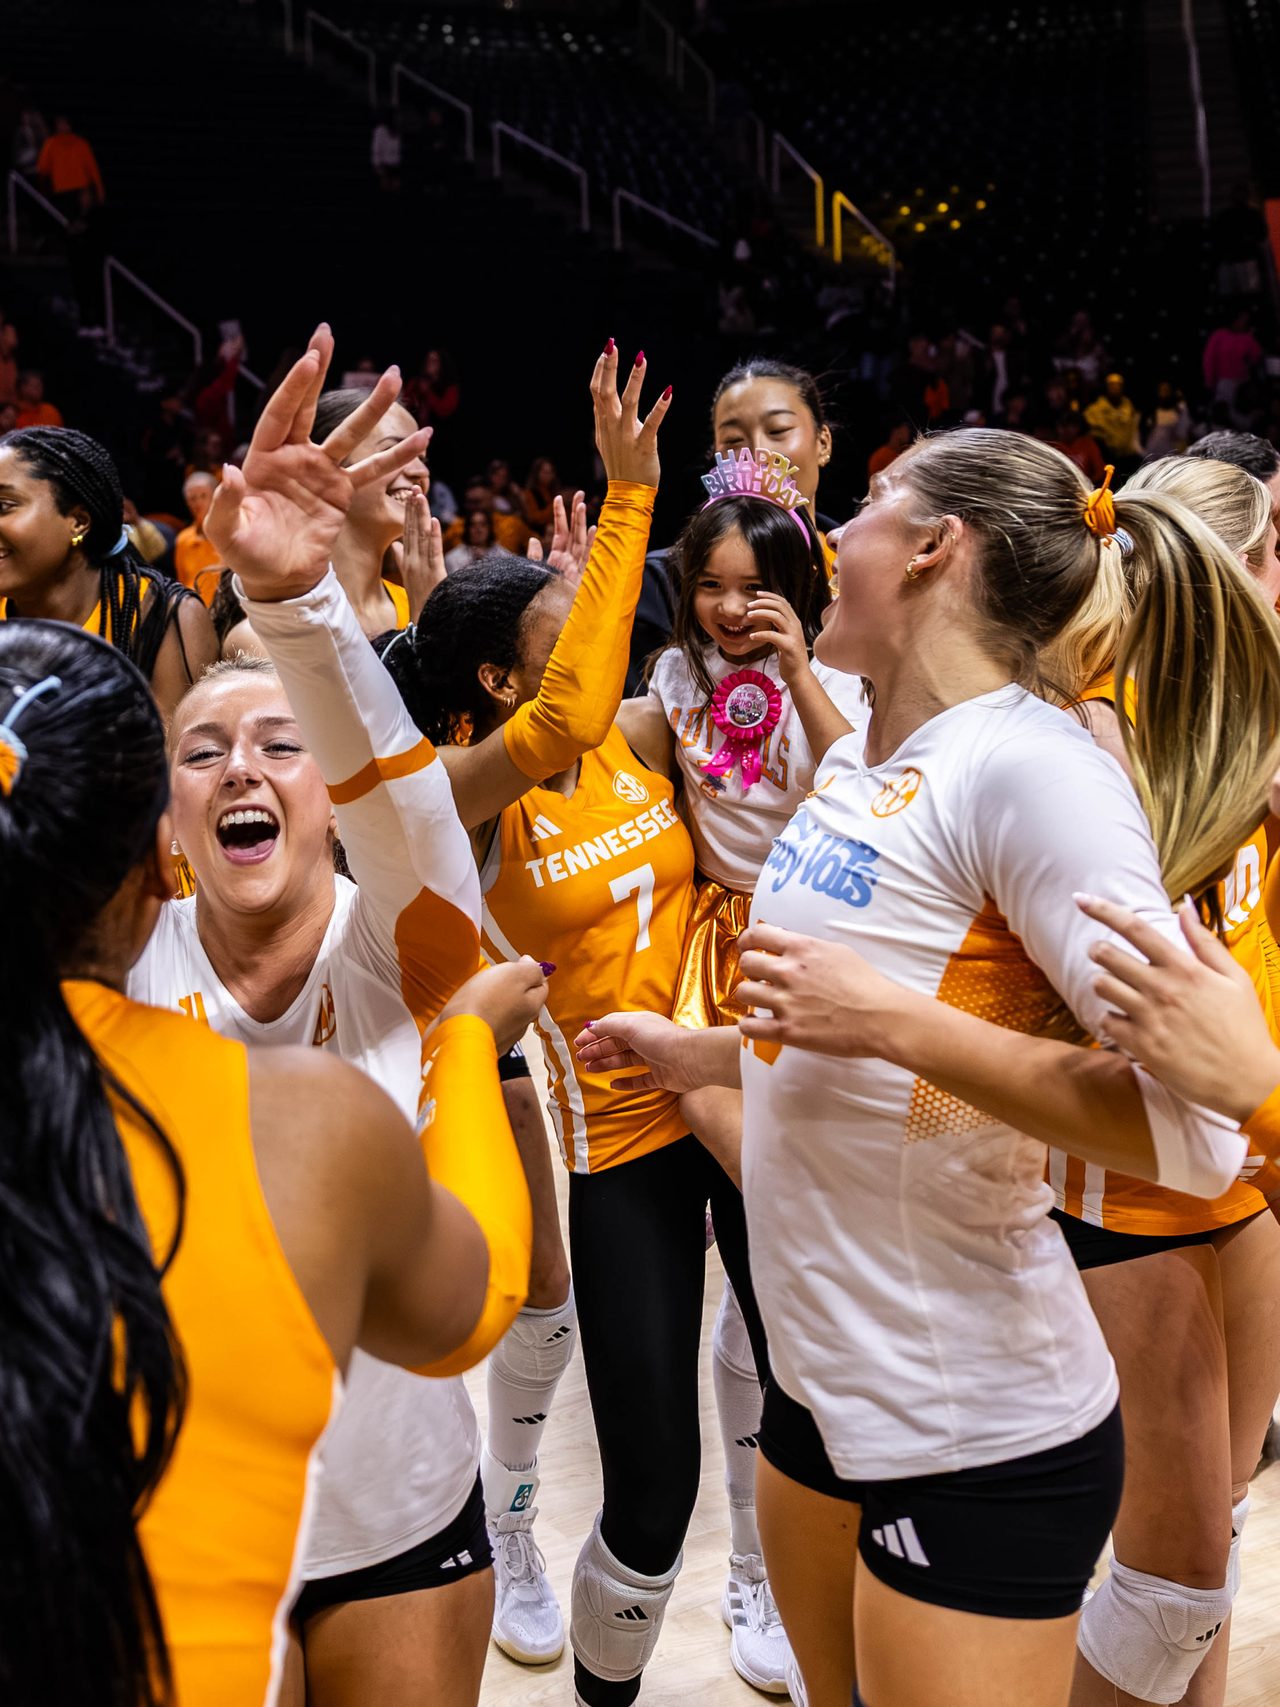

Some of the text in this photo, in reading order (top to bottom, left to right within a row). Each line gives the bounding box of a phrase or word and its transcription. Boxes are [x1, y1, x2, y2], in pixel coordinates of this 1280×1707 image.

[700, 468, 810, 510] BIRTHDAY
[714, 447, 800, 479] HAPPY
[525, 798, 678, 888] TENNESSEE
[608, 863, 655, 952] 7
